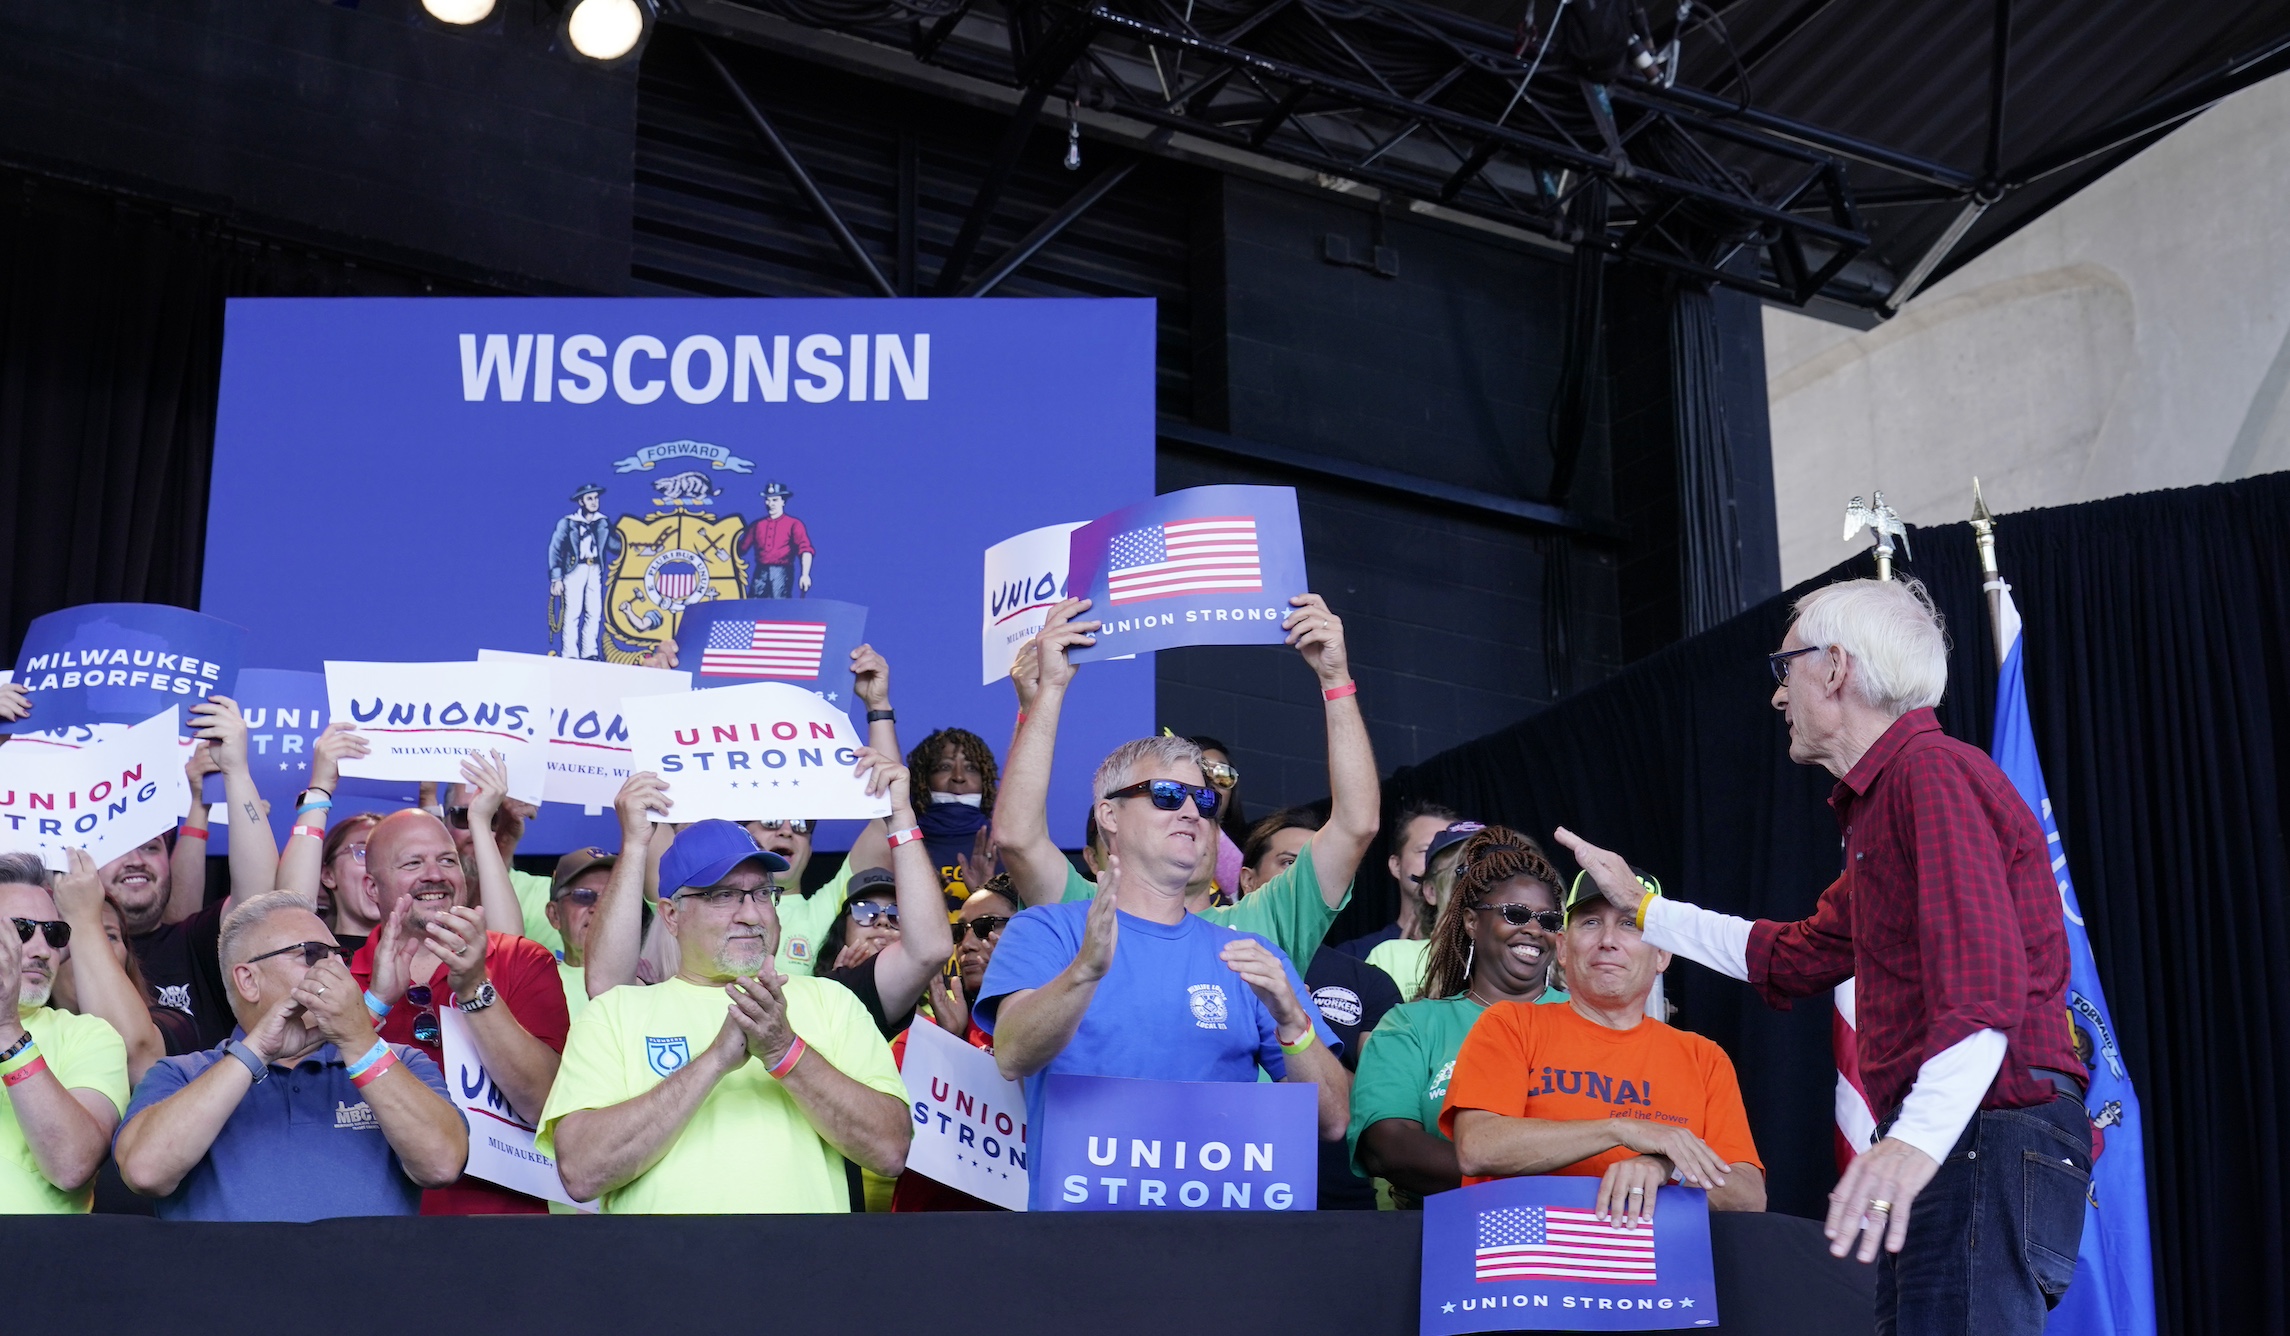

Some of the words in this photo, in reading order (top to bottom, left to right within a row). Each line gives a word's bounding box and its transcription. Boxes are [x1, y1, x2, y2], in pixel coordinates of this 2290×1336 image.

[459, 333, 930, 404] WISCONSIN
[647, 443, 719, 459] FORWARD
[992, 572, 1067, 616] UNIO
[1102, 613, 1174, 635] UNION
[1186, 608, 1277, 622] STRONG
[26, 649, 221, 680] MILWAUKEE
[23, 669, 213, 698] LABORFEST
[351, 697, 534, 735] UNIONS.
[675, 722, 835, 745] UNION
[661, 747, 859, 772] STRONG
[1313, 997, 1361, 1016] WORKERS
[2073, 997, 2113, 1049] FORWARD
[1528, 1066, 1651, 1106] LiUNA!
[1609, 1108, 1632, 1119] Feel
[1635, 1109, 1651, 1120] the
[1655, 1111, 1689, 1125] Power
[488, 1136, 554, 1169] MILWAUKEE,
[1088, 1136, 1273, 1171] UNION
[1063, 1175, 1293, 1210] STRONG
[1462, 1295, 1548, 1311] UNION
[1562, 1296, 1673, 1310] STRONG
